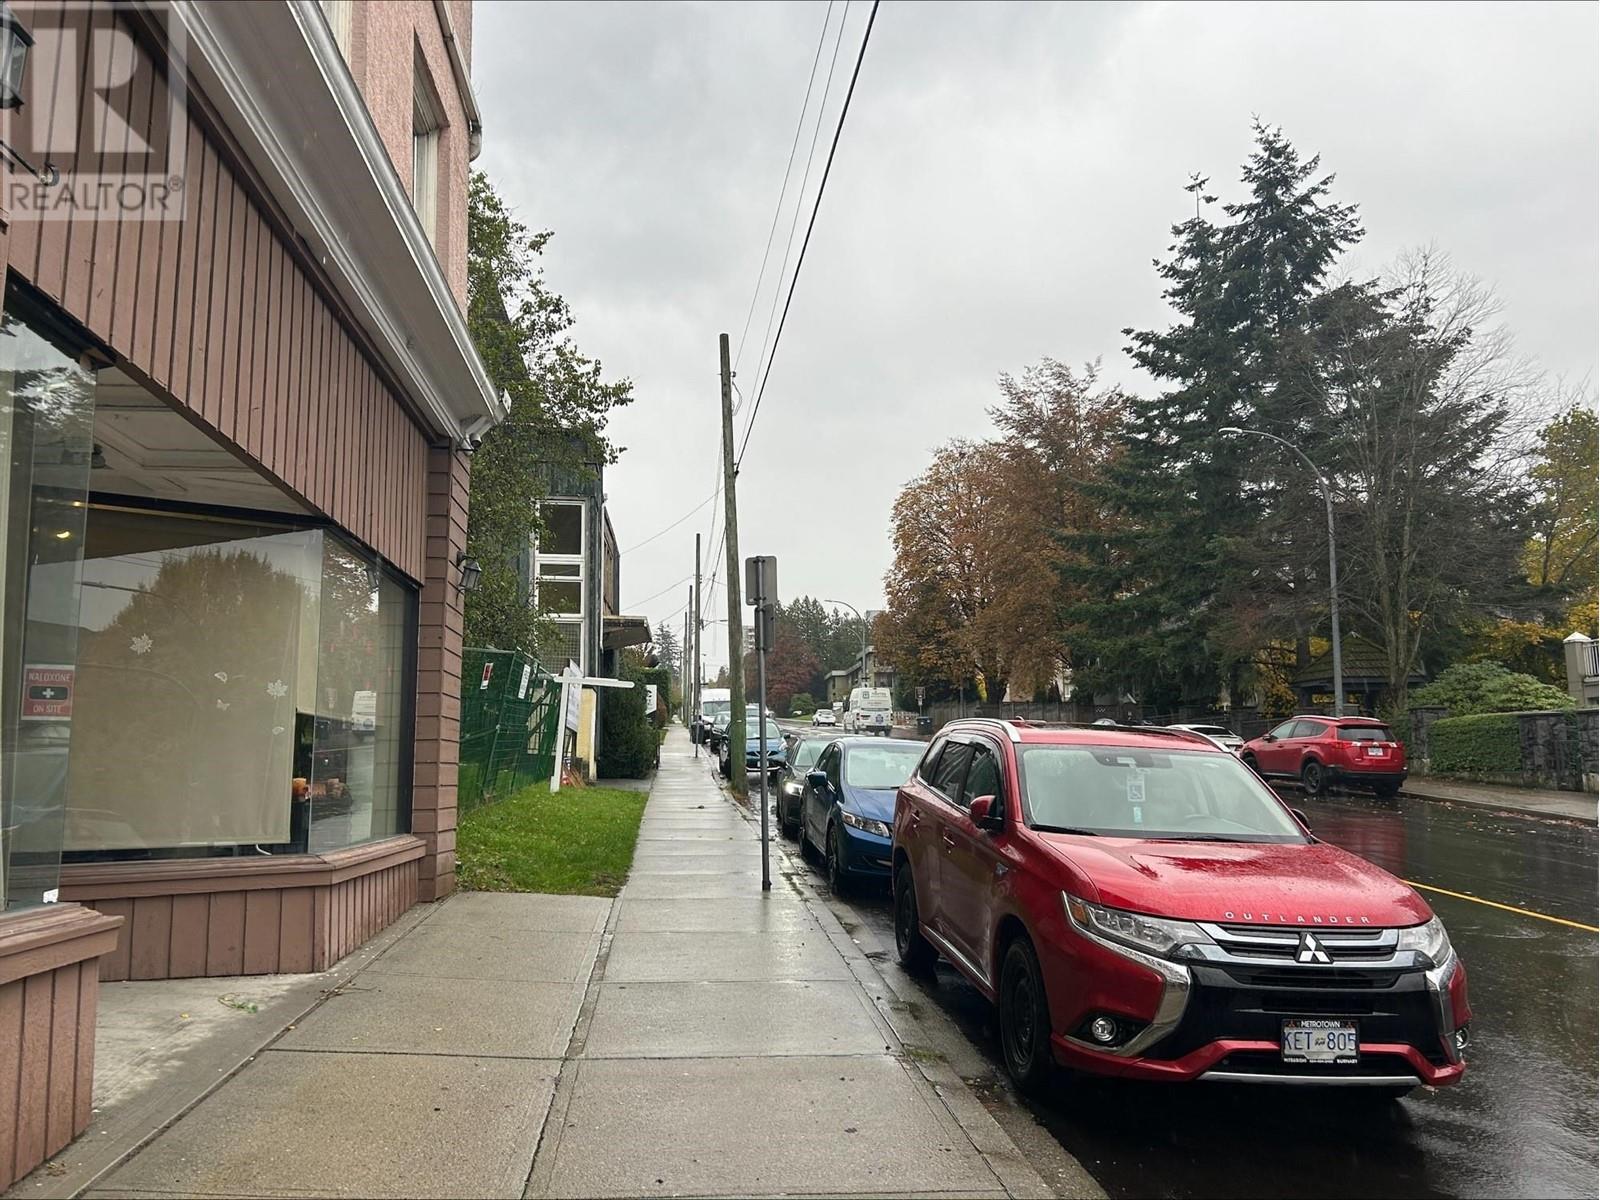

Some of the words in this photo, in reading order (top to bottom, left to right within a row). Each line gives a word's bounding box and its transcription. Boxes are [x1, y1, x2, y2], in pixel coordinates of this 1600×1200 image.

[28, 672, 71, 681] NALOXONE
[33, 704, 44, 713] ON
[46, 704, 64, 714] SITE
[1225, 911, 1370, 924] OUTLANDER
[1301, 1020, 1340, 1028] METROTOWN
[1283, 1031, 1313, 1050] KET
[1327, 1031, 1357, 1051] 805
